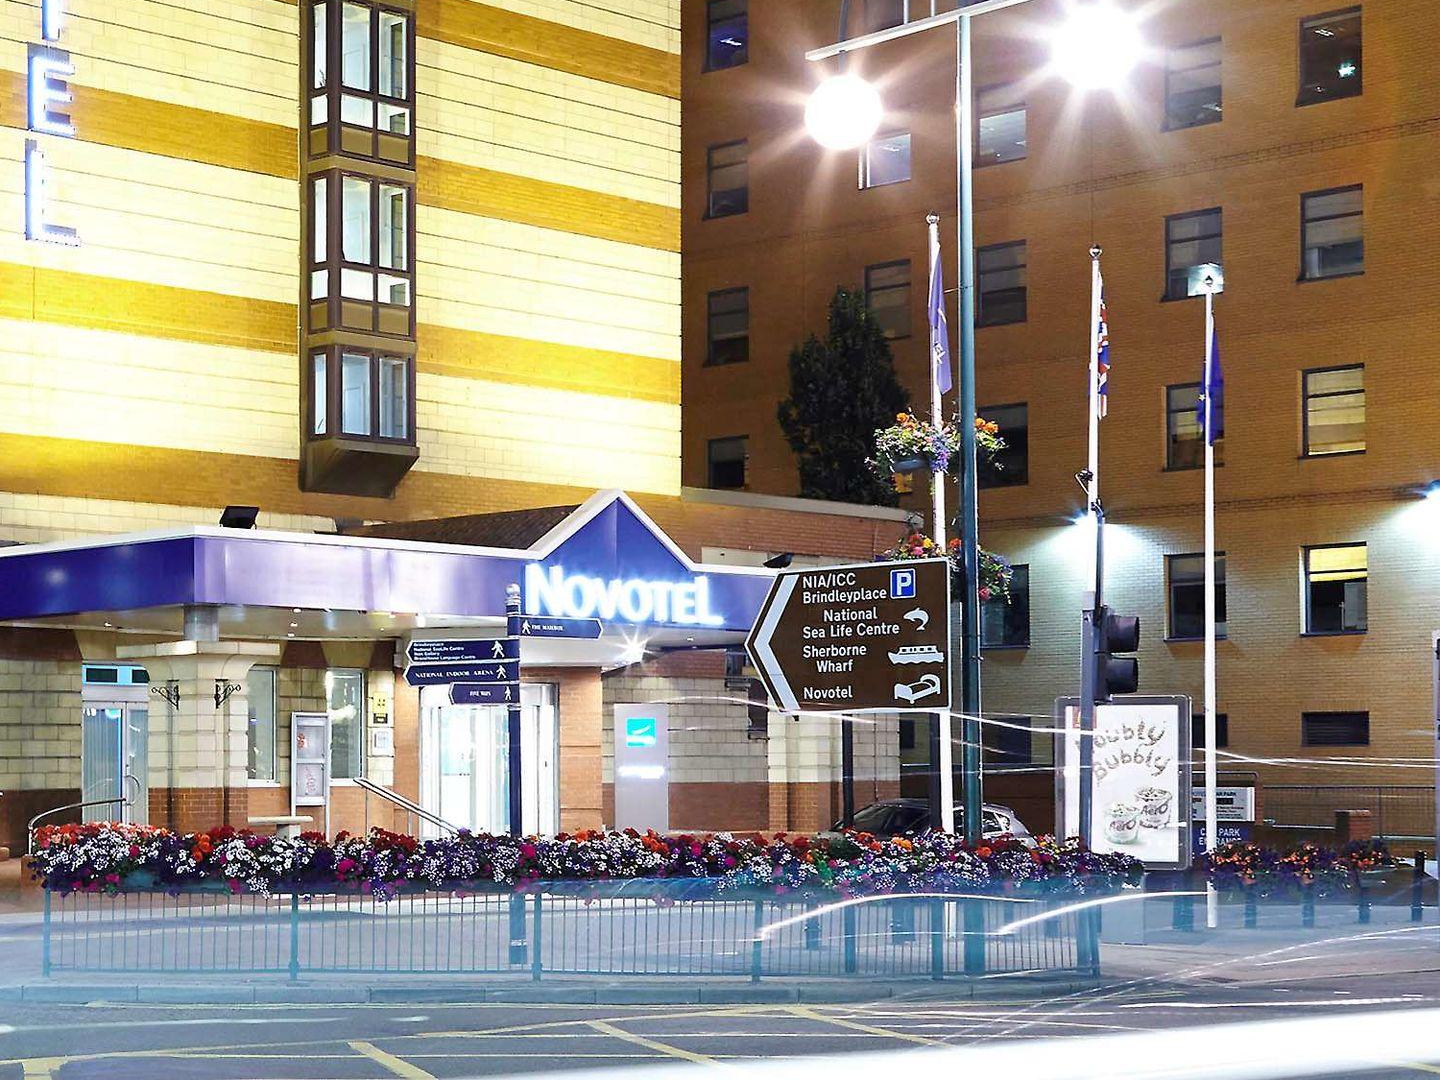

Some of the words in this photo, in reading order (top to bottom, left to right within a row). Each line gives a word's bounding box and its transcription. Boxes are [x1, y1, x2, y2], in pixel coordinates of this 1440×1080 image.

[802, 572, 856, 589] NIA/ICC
[524, 562, 724, 626] NOVOTEL
[802, 588, 887, 604] Brindleyplace
[823, 607, 878, 622] National
[802, 626, 826, 639] Sea
[830, 625, 853, 637] Life
[856, 622, 900, 636] Centre
[802, 644, 867, 658] Sherborne
[816, 659, 853, 673] Wharf
[803, 685, 853, 700] Novotel
[1218, 827, 1241, 837] PARK
